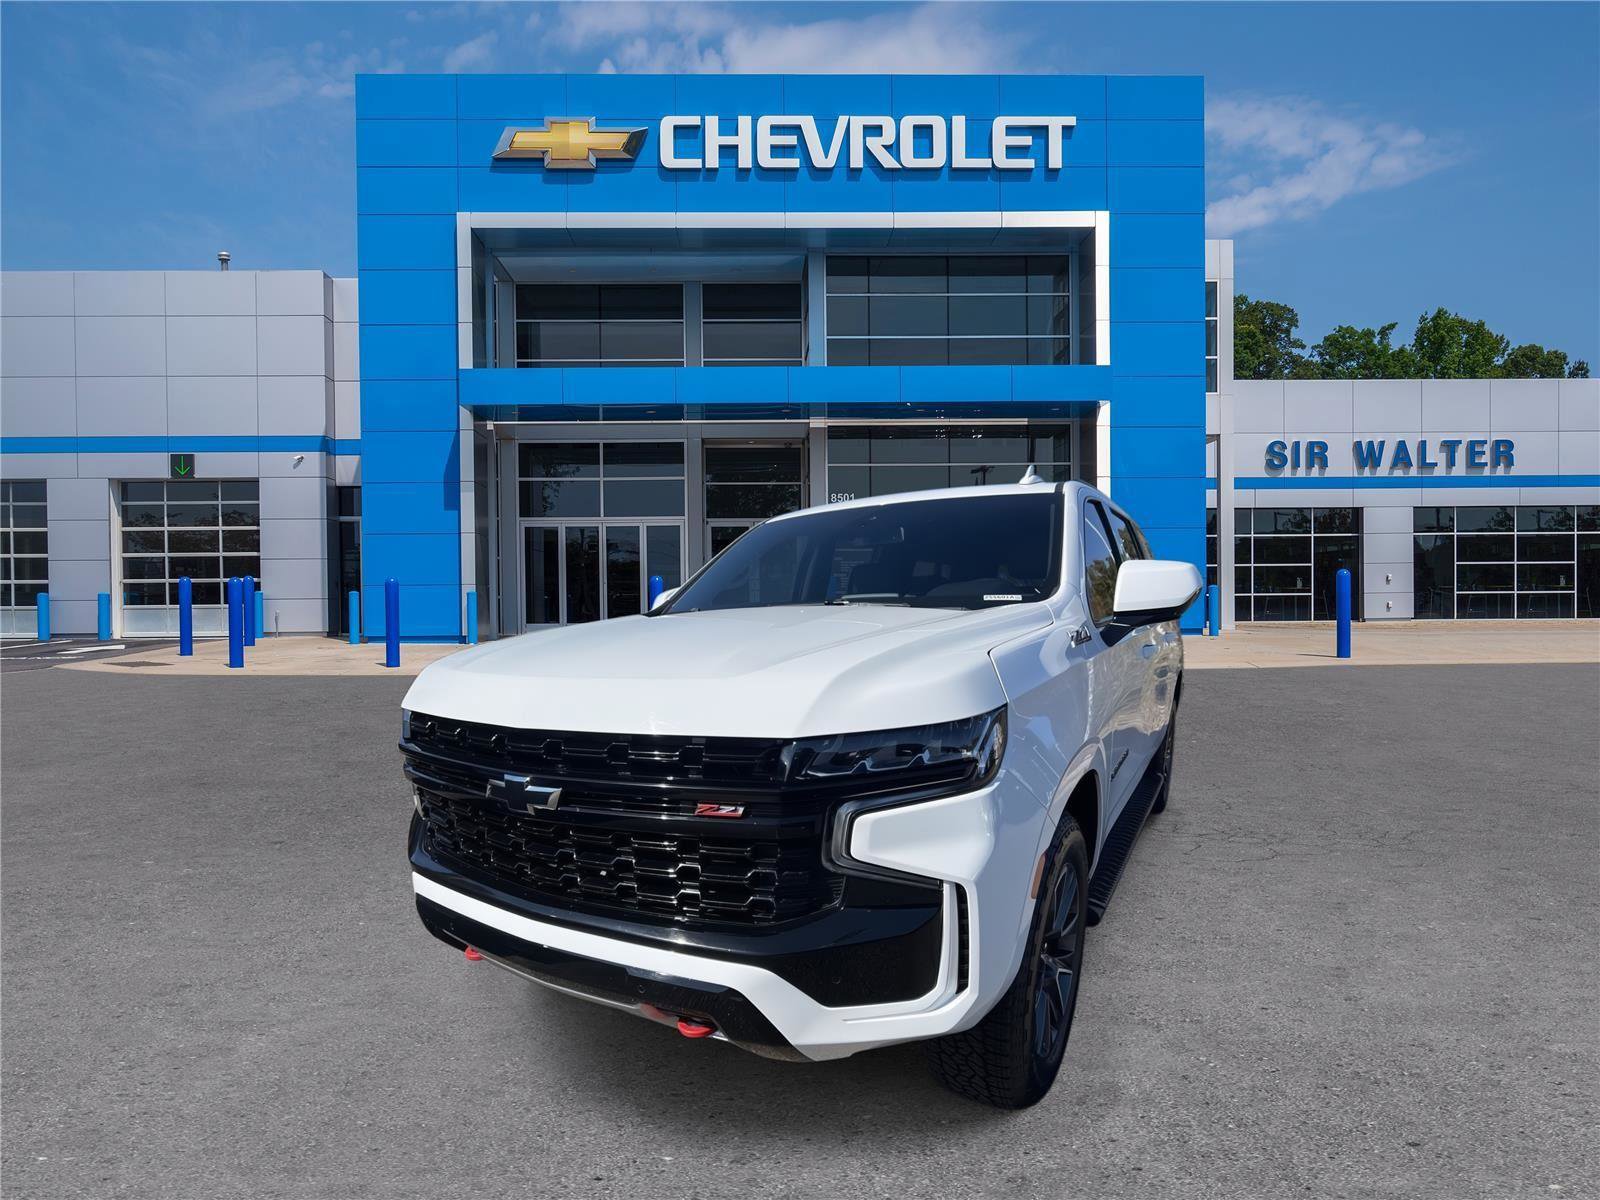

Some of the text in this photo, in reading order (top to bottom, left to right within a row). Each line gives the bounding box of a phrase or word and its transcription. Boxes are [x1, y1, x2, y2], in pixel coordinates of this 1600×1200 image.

[660, 115, 1077, 169] CHEVROLET
[1265, 439, 1515, 470] SIR WALTER
[830, 492, 855, 503] 8501
